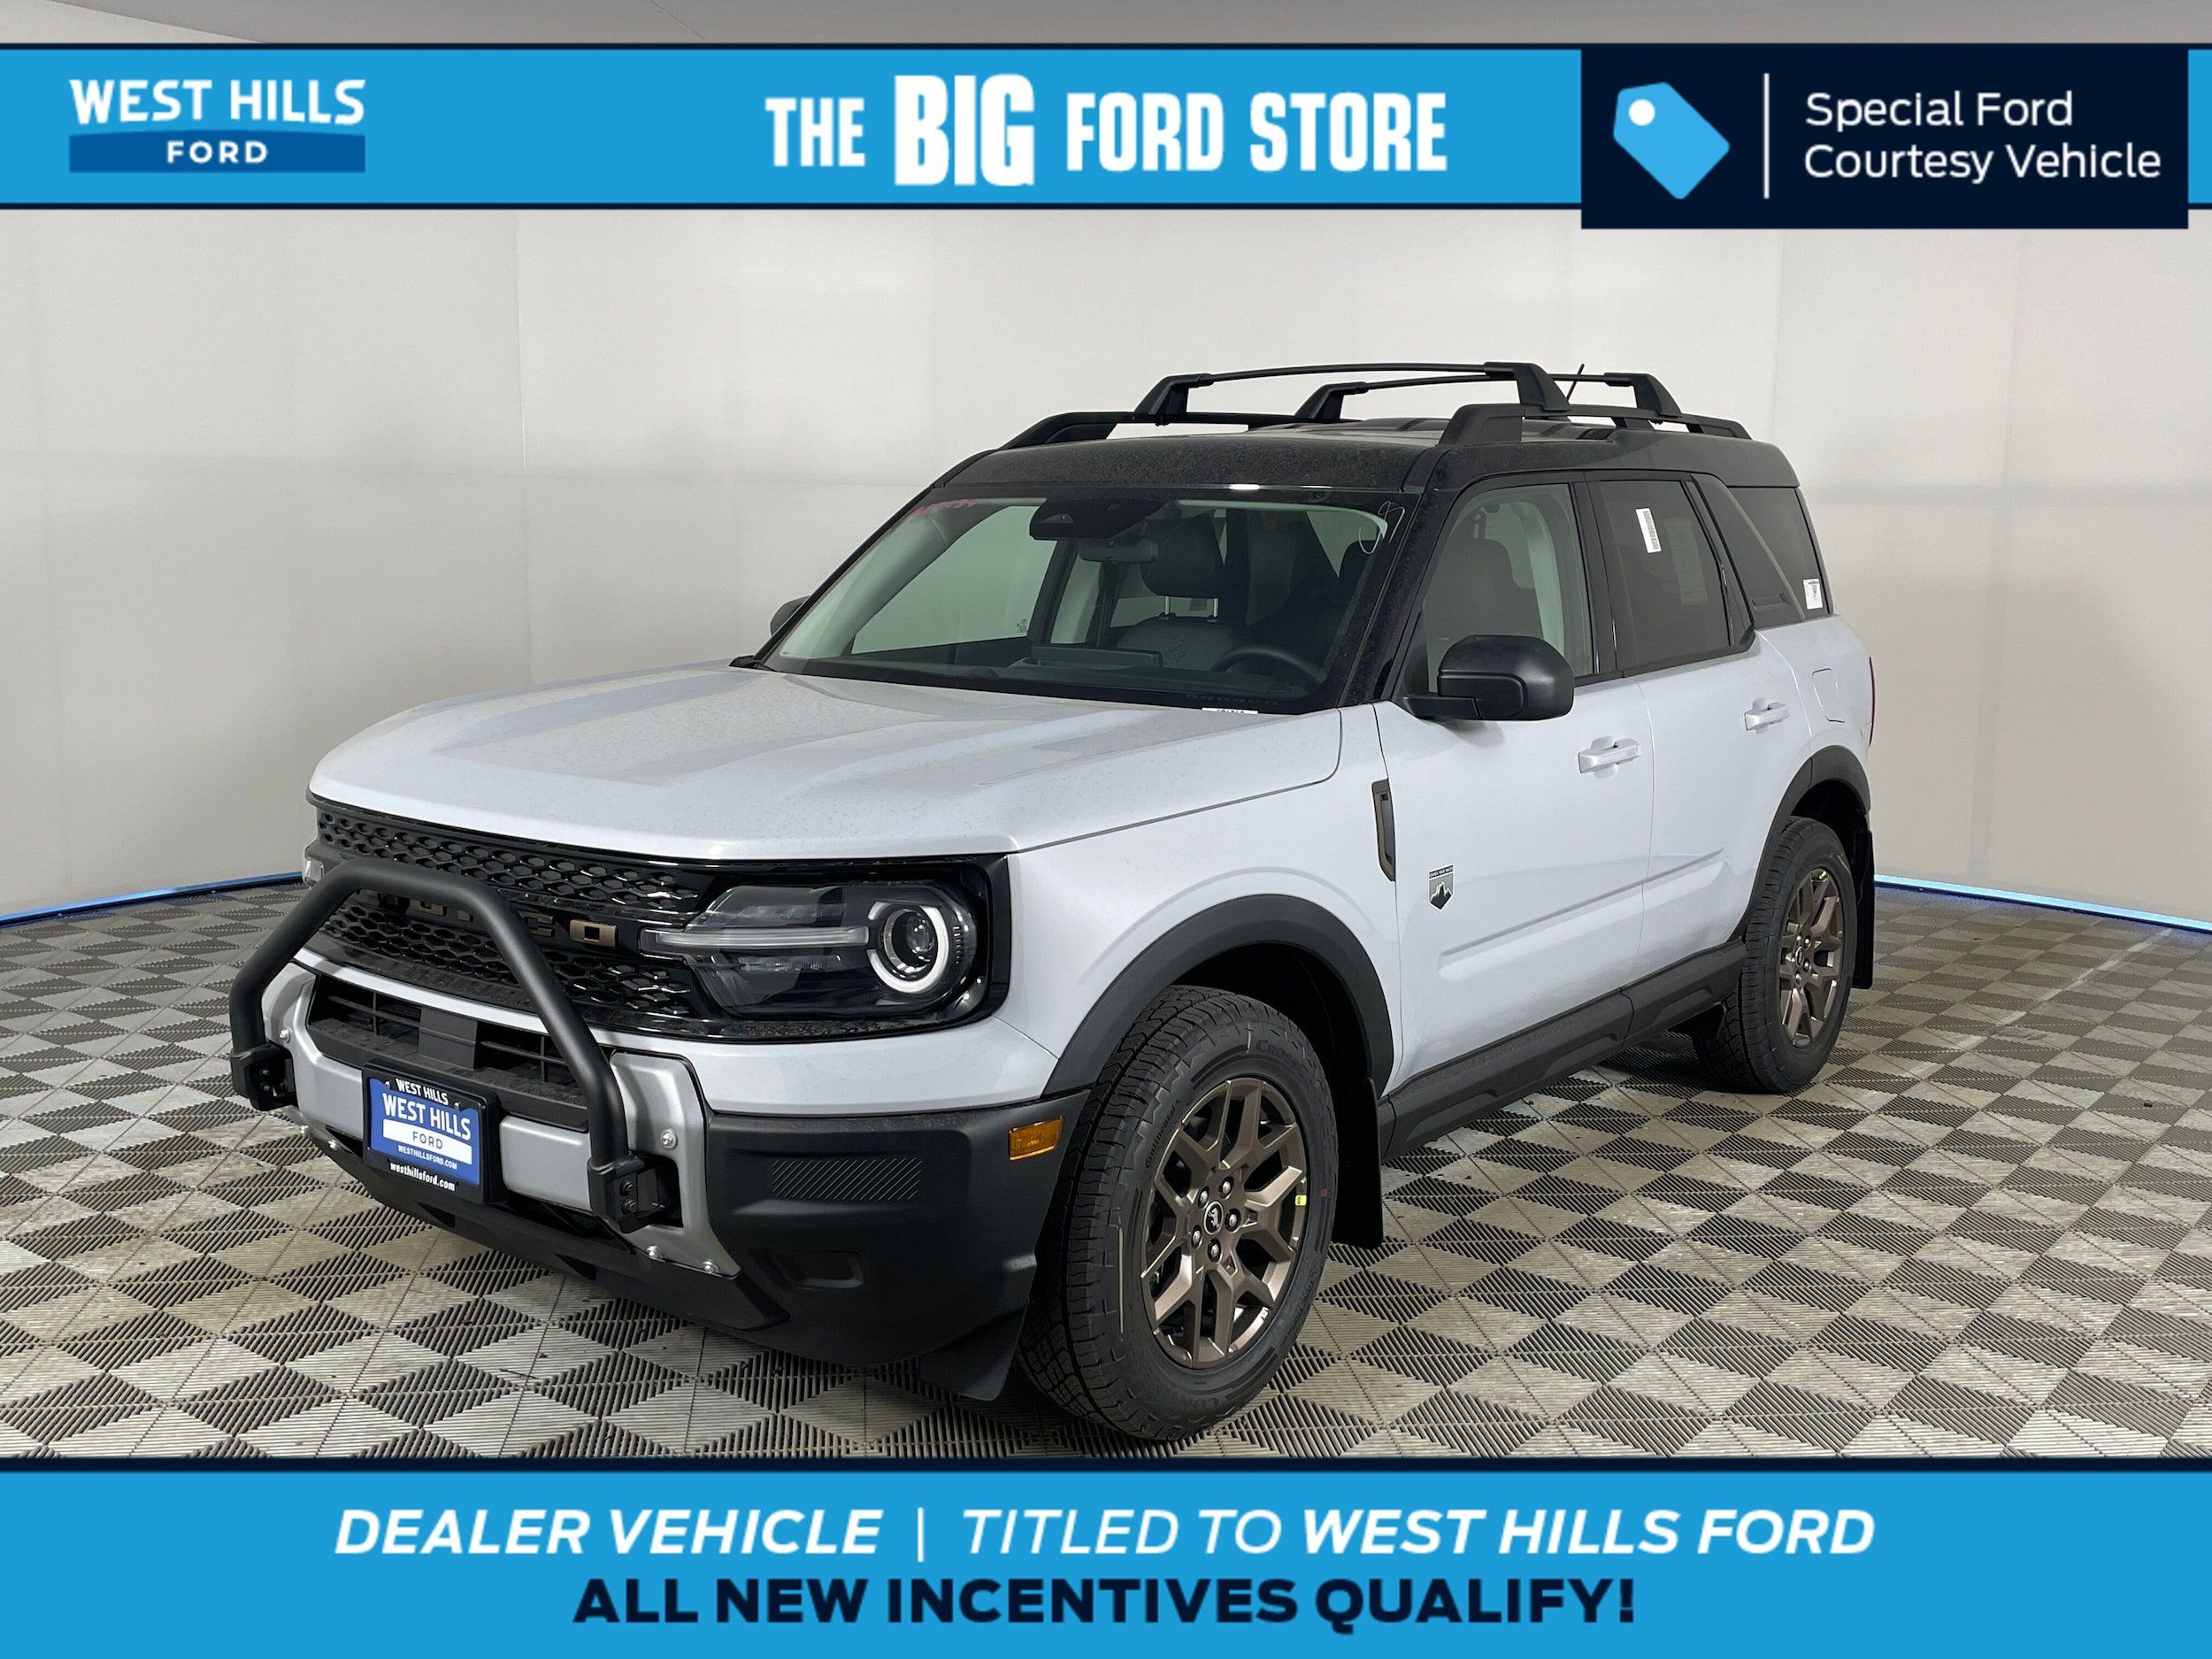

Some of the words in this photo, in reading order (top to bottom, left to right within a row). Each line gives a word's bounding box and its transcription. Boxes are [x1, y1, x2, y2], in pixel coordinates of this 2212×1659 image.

[396, 1078, 422, 1095] WEST
[423, 1087, 449, 1105] HILLS
[382, 1093, 426, 1124] WEST
[430, 1107, 471, 1141] HILLS
[412, 1131, 443, 1149] FORD
[397, 1145, 457, 1170] WESTHILLSFORD.COM
[390, 1162, 455, 1191] westhillsford.com
